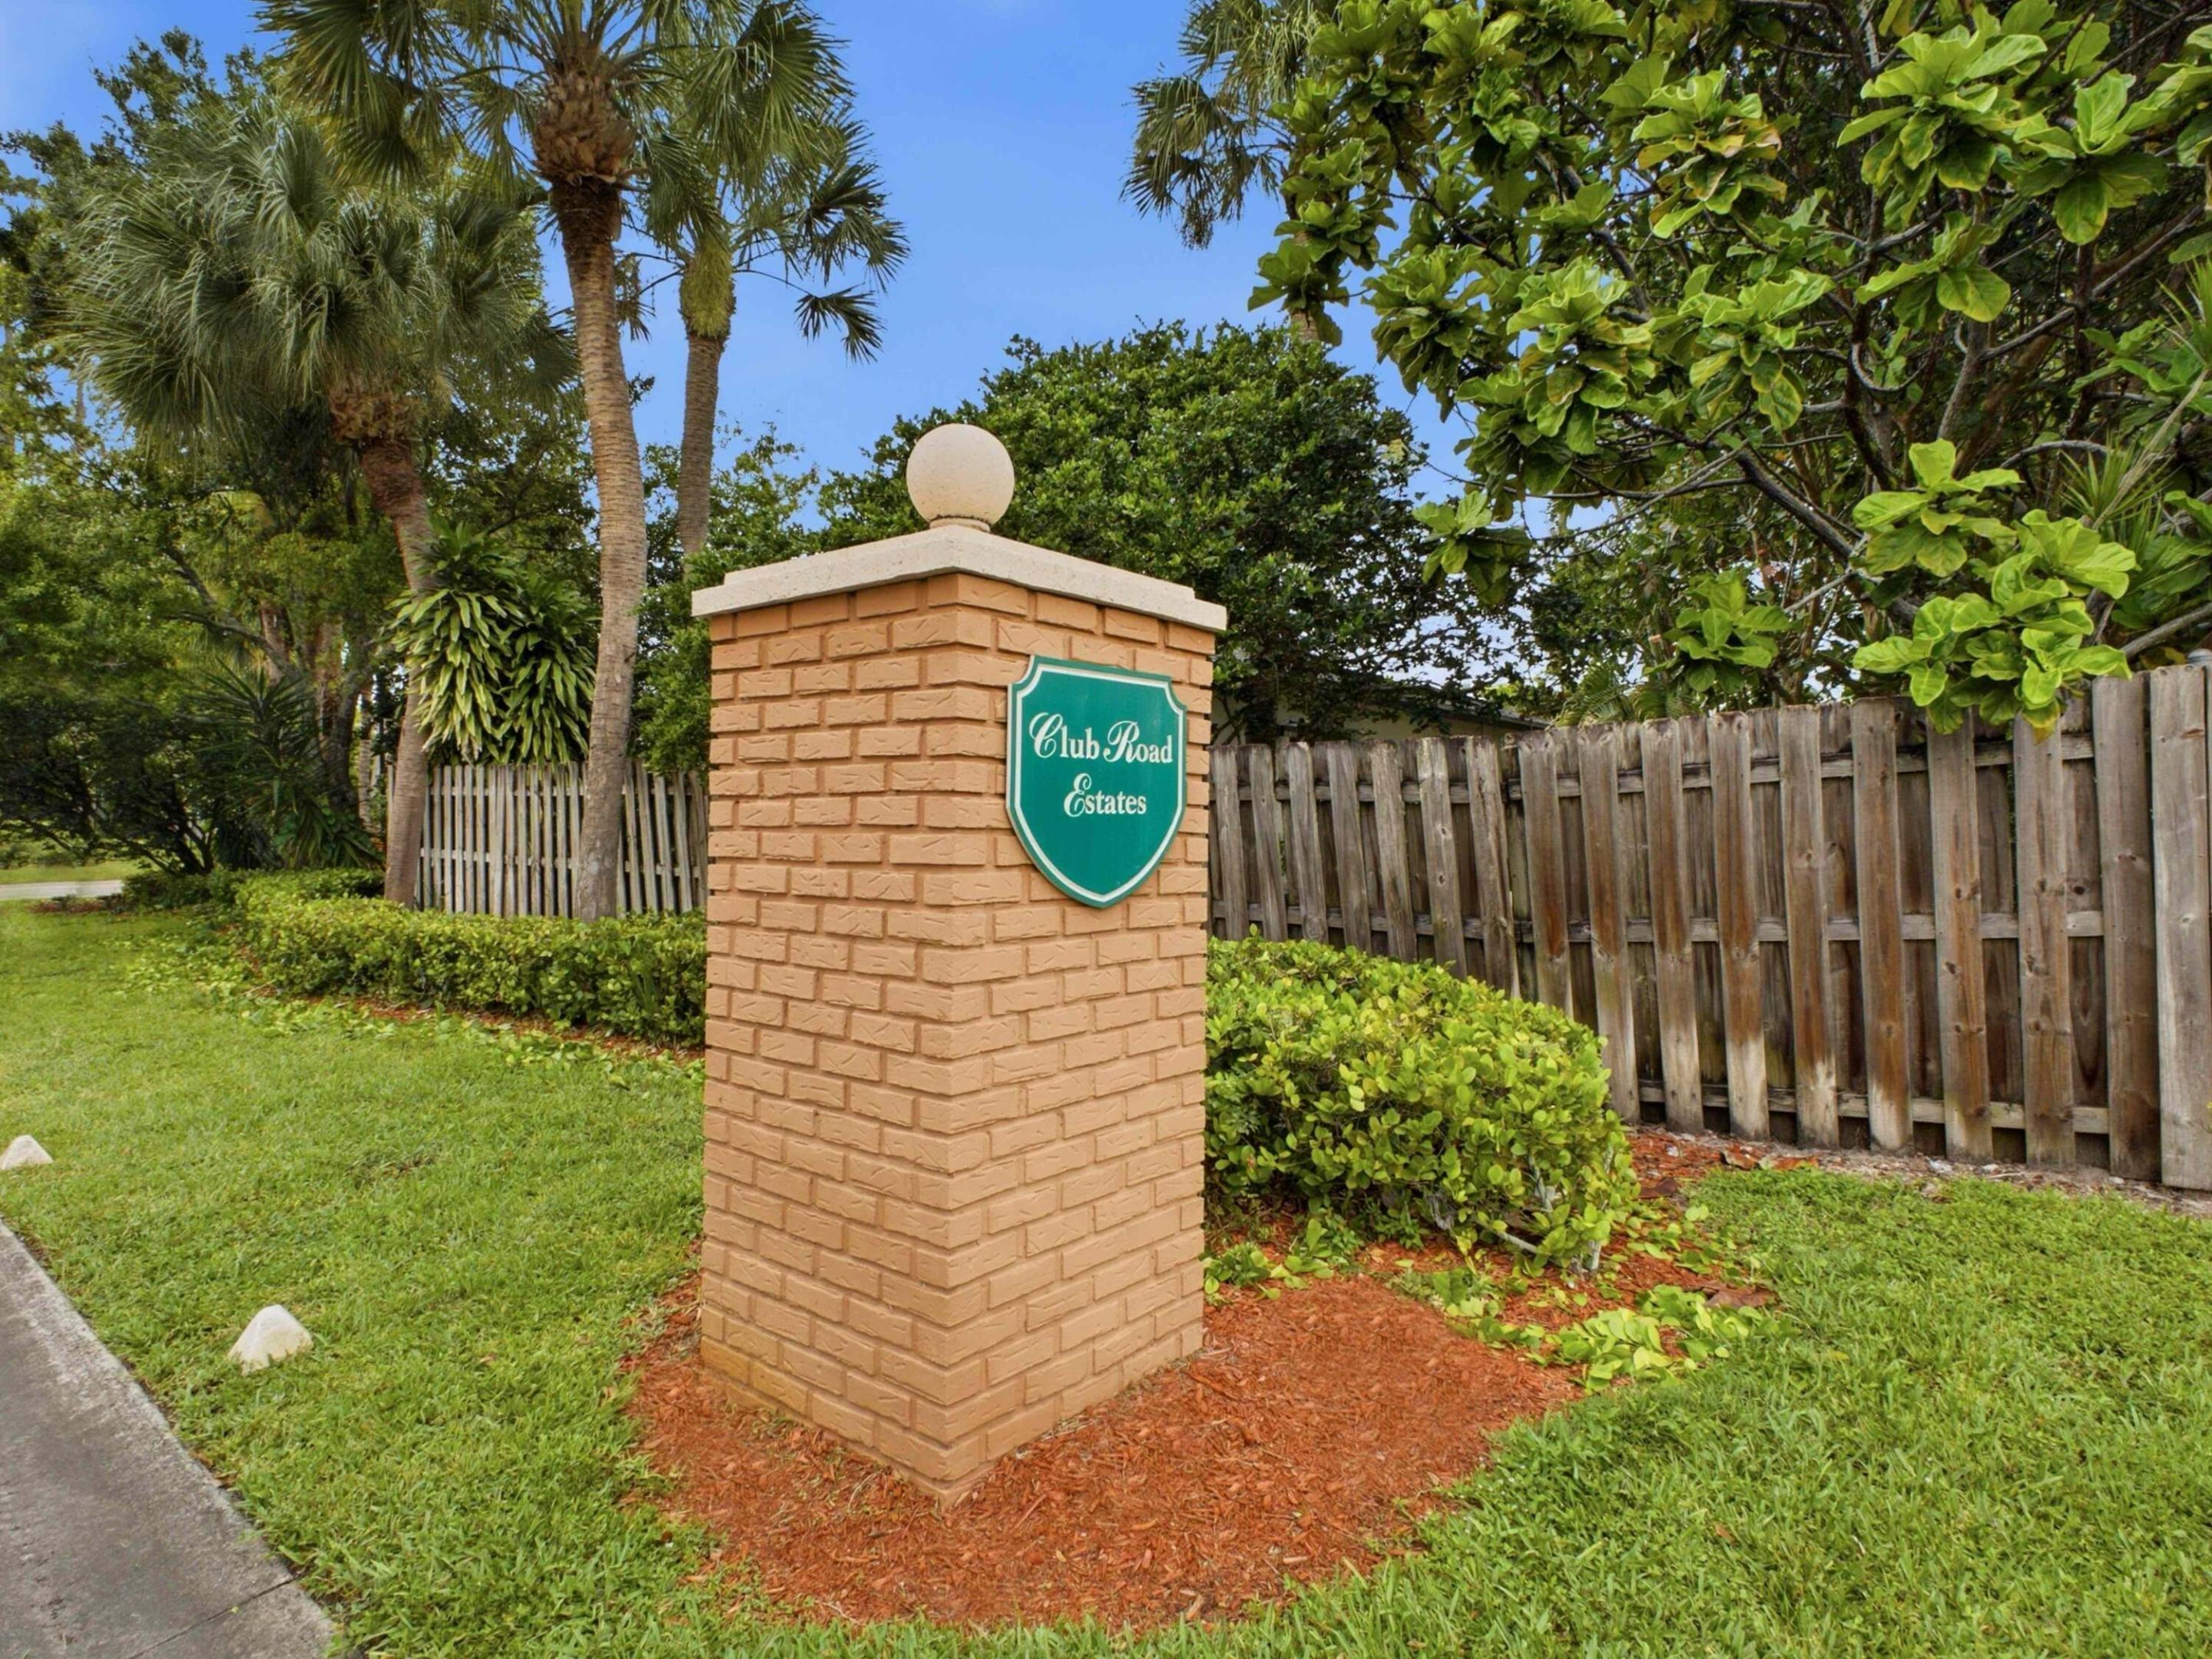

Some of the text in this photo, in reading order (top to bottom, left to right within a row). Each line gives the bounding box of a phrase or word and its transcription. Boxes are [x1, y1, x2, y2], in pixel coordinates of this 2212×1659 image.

[1029, 712, 1173, 763] Club Road
[1064, 773, 1147, 817] Estates
